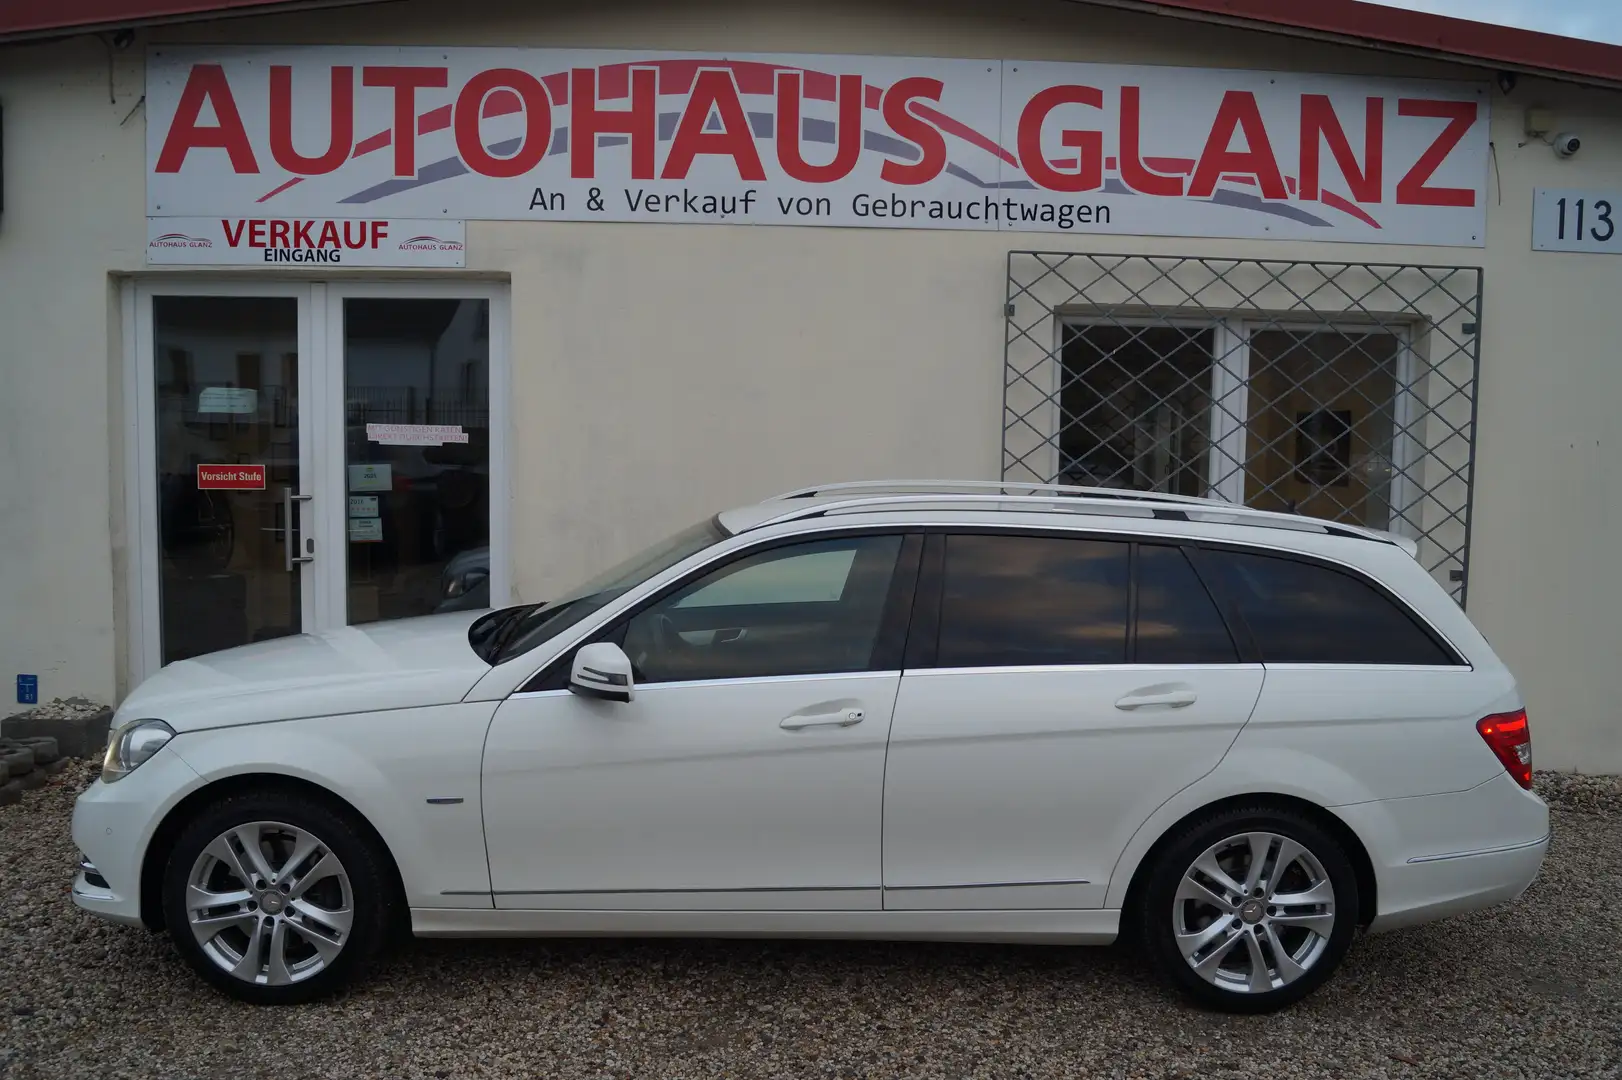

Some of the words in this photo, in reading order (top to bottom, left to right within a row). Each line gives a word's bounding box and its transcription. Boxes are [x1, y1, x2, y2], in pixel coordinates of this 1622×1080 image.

[154, 63, 948, 187] AUTOHAUS
[1016, 84, 1479, 207] GLANZ
[529, 187, 565, 211] An
[586, 187, 605, 212] &
[624, 188, 757, 214] Verkauf
[777, 196, 832, 217] von
[852, 193, 1111, 229] Gebrauchtwagen
[1556, 197, 1615, 242] 113
[221, 219, 389, 249] VERKAUF
[264, 248, 341, 263] EINGANG
[201, 471, 237, 481] Vorsicht
[239, 472, 262, 481] Stufe
